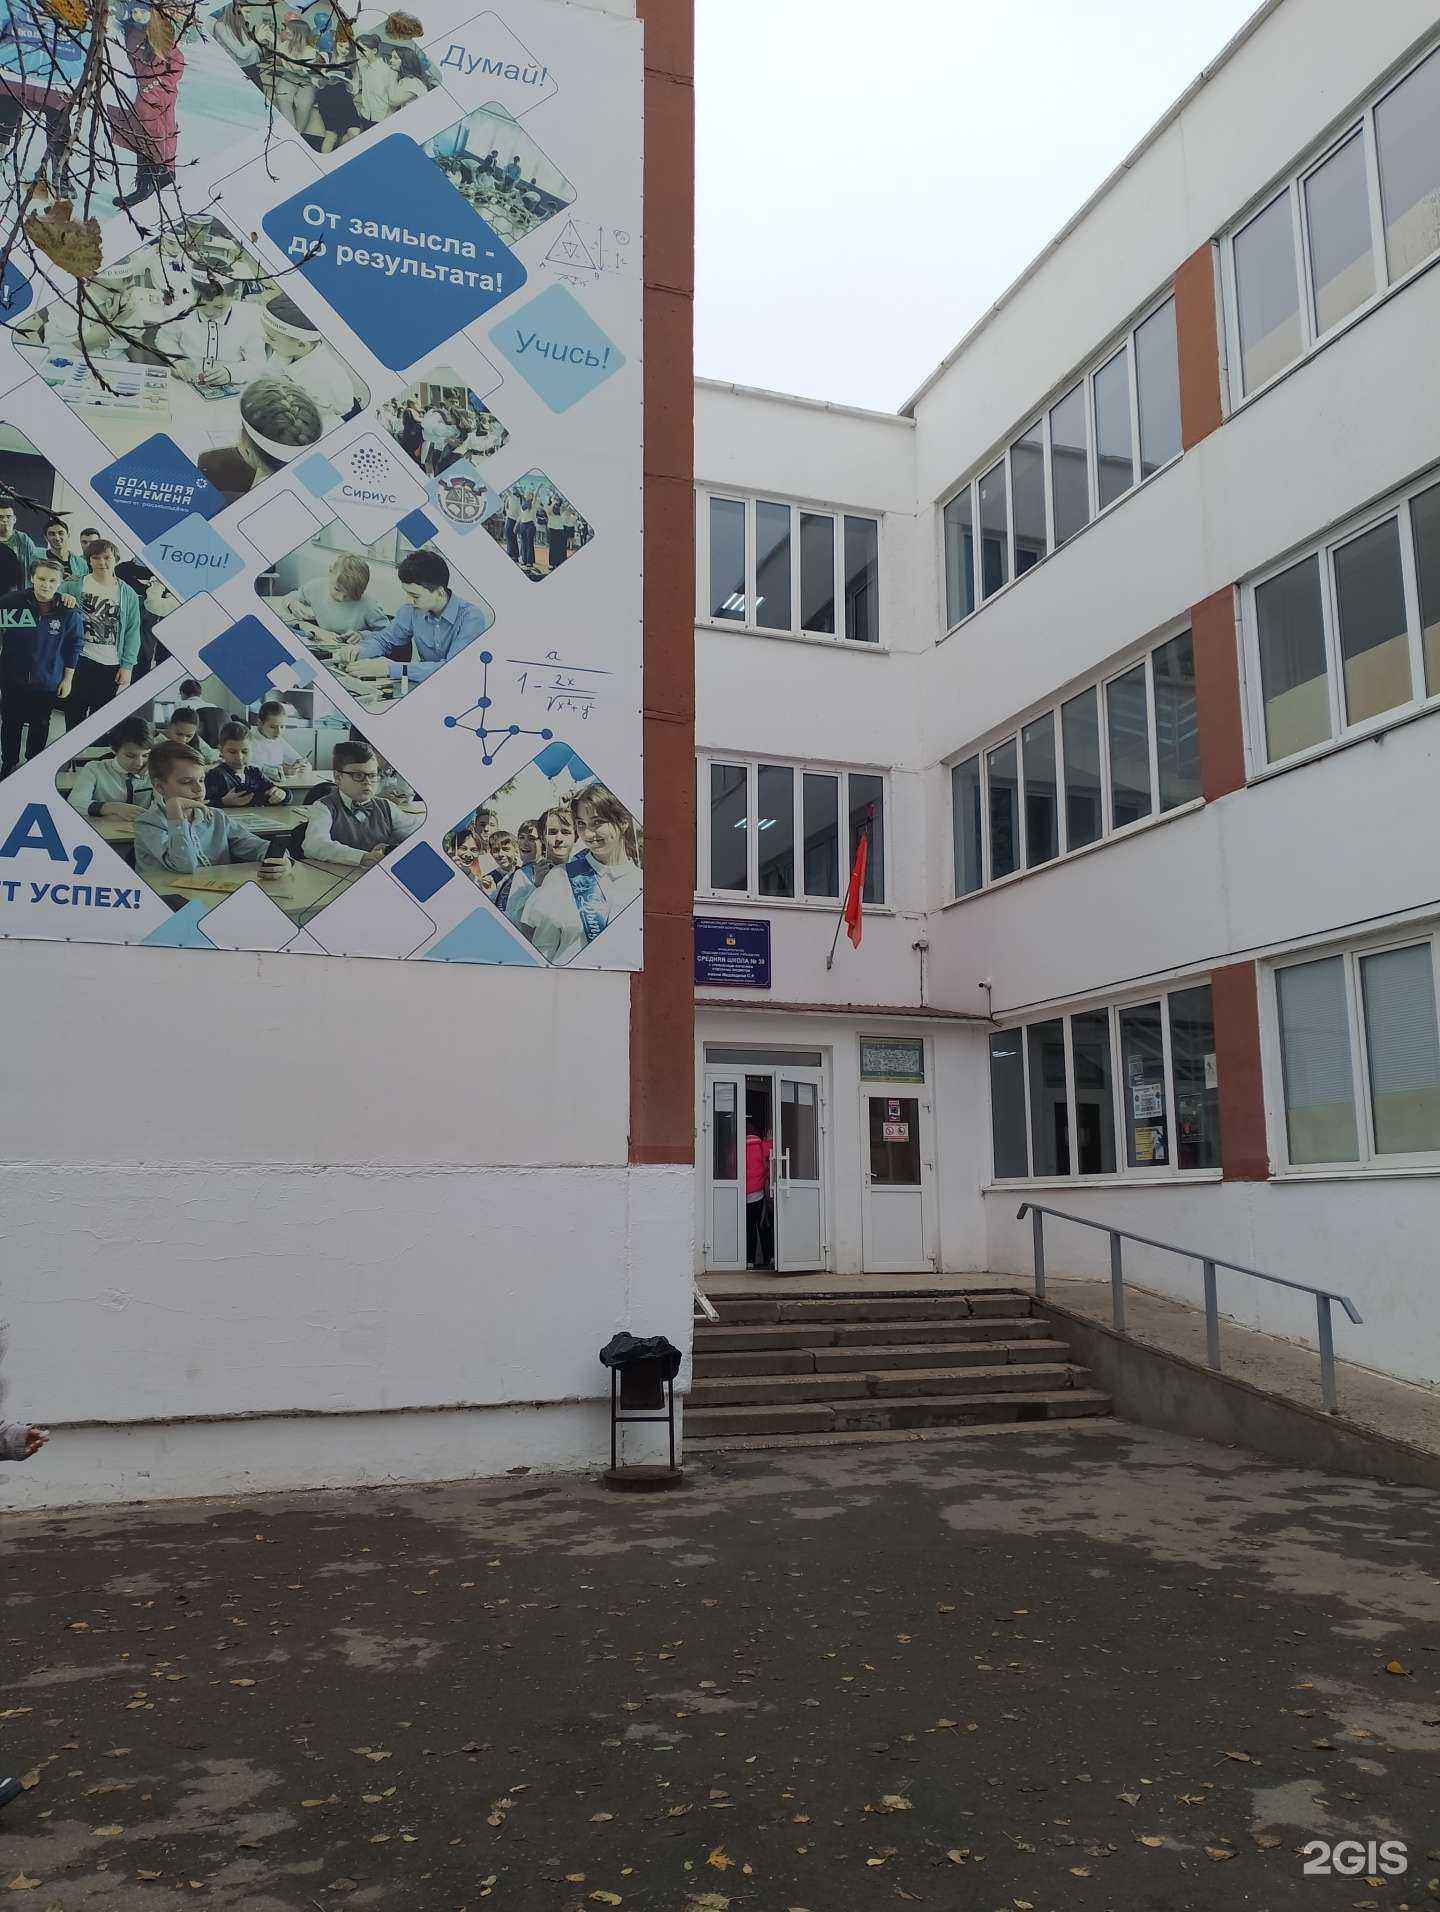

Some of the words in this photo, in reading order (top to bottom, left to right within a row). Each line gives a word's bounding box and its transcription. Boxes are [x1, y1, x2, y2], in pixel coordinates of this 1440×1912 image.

[439, 44, 548, 87] Думай!
[302, 204, 342, 230] От
[348, 218, 477, 259] замысла
[288, 236, 327, 257] до
[336, 243, 503, 293] результата!
[516, 329, 610, 369] Учись!
[113, 486, 192, 505] ПЕРЕМЕНА
[116, 476, 195, 496] БОЛЬШАЯ
[342, 485, 397, 504] Сириус
[160, 543, 229, 569] Твори!
[0, 880, 21, 902] Т
[30, 882, 141, 909] УСПЕХ!
